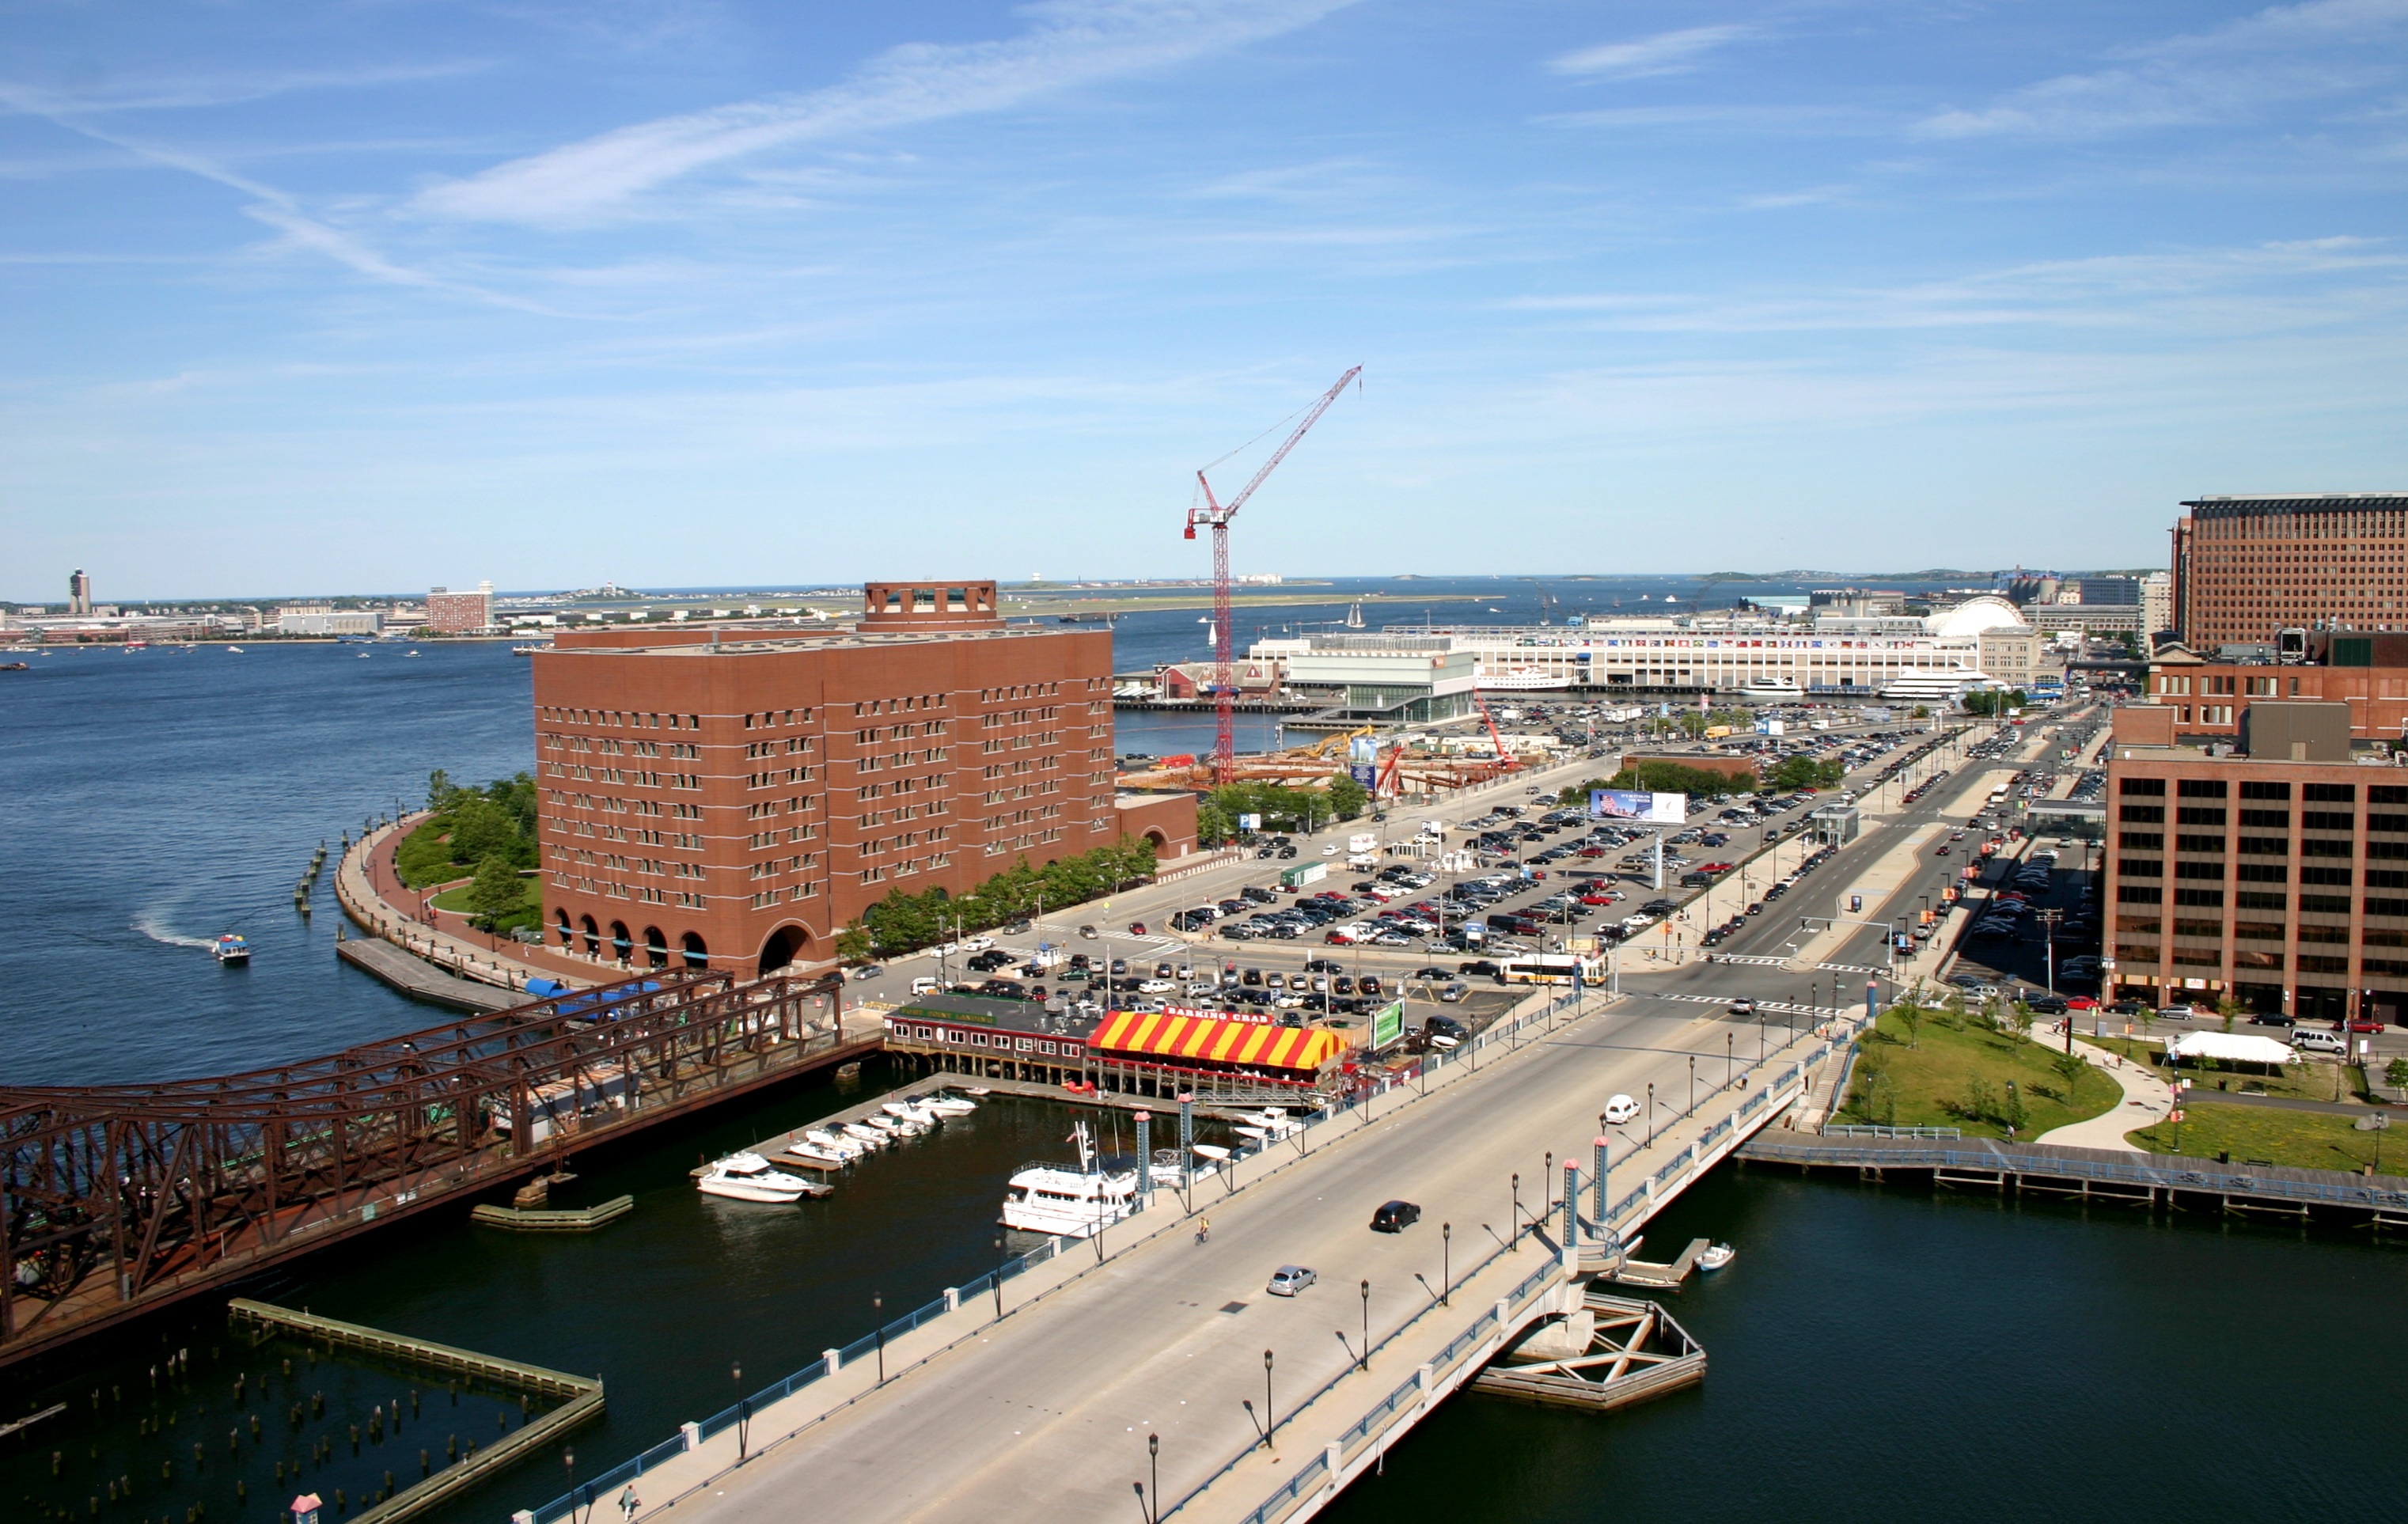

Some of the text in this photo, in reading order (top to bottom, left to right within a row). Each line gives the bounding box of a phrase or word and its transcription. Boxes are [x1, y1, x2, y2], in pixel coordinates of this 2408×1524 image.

[1240, 815, 1249, 825] P
[956, 1014, 994, 1024] LANDING
[1168, 1007, 1268, 1023] BARKING CRAB
